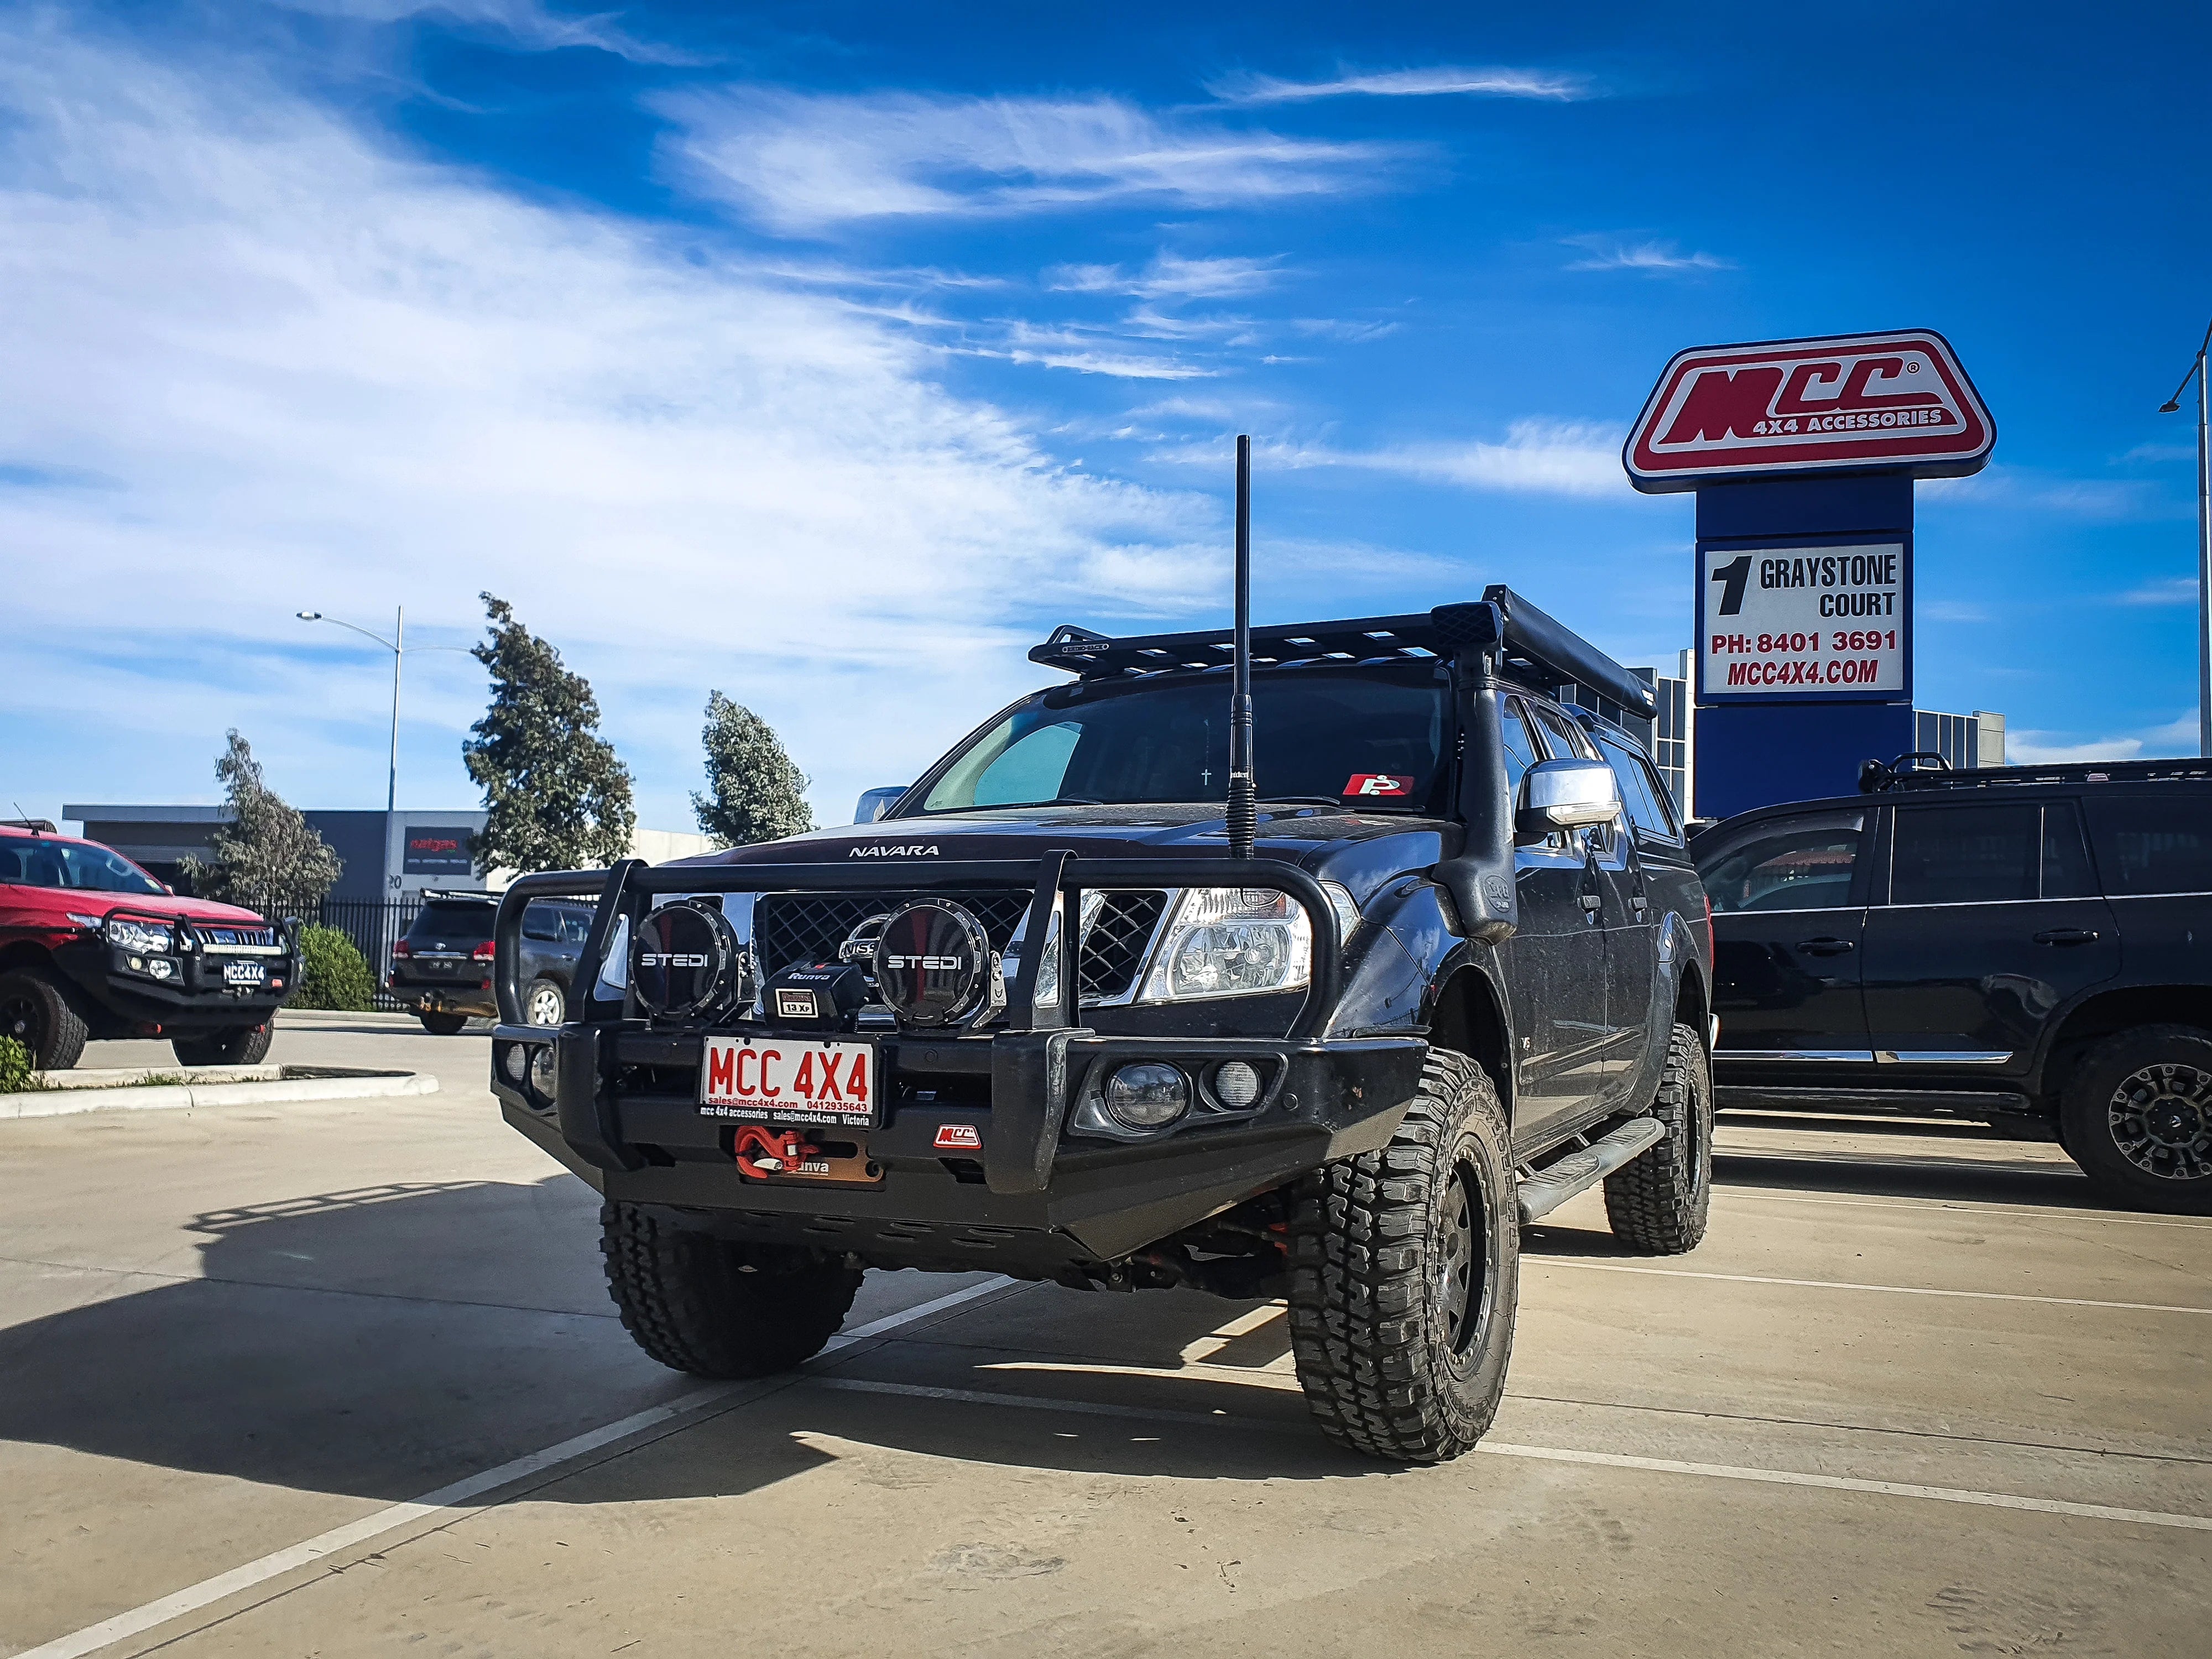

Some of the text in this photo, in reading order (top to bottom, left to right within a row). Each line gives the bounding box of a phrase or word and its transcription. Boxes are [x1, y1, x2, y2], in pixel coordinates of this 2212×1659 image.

[1656, 357, 1944, 445] MCC
[1752, 409, 1942, 436] 4X4 ACCESSORIES
[1711, 554, 1897, 616] 1 GRAYSTONE
[1819, 591, 1896, 618] COURT
[1712, 629, 1896, 654] PH: 8401 3691
[1727, 659, 1879, 686] MCC4X4.COM
[848, 844, 940, 857] NAVARA
[223, 964, 264, 980] MCC4X4
[641, 953, 708, 968] STEDI
[887, 955, 962, 970] STEDI
[708, 1047, 868, 1102] MCC 4X4
[700, 1105, 869, 1126] mcc 4x4 accessories sales@mcc4x4.com Victoria
[708, 1096, 867, 1112] sales@mcc4x4.com 0412935643
[938, 1128, 975, 1142] MCC
